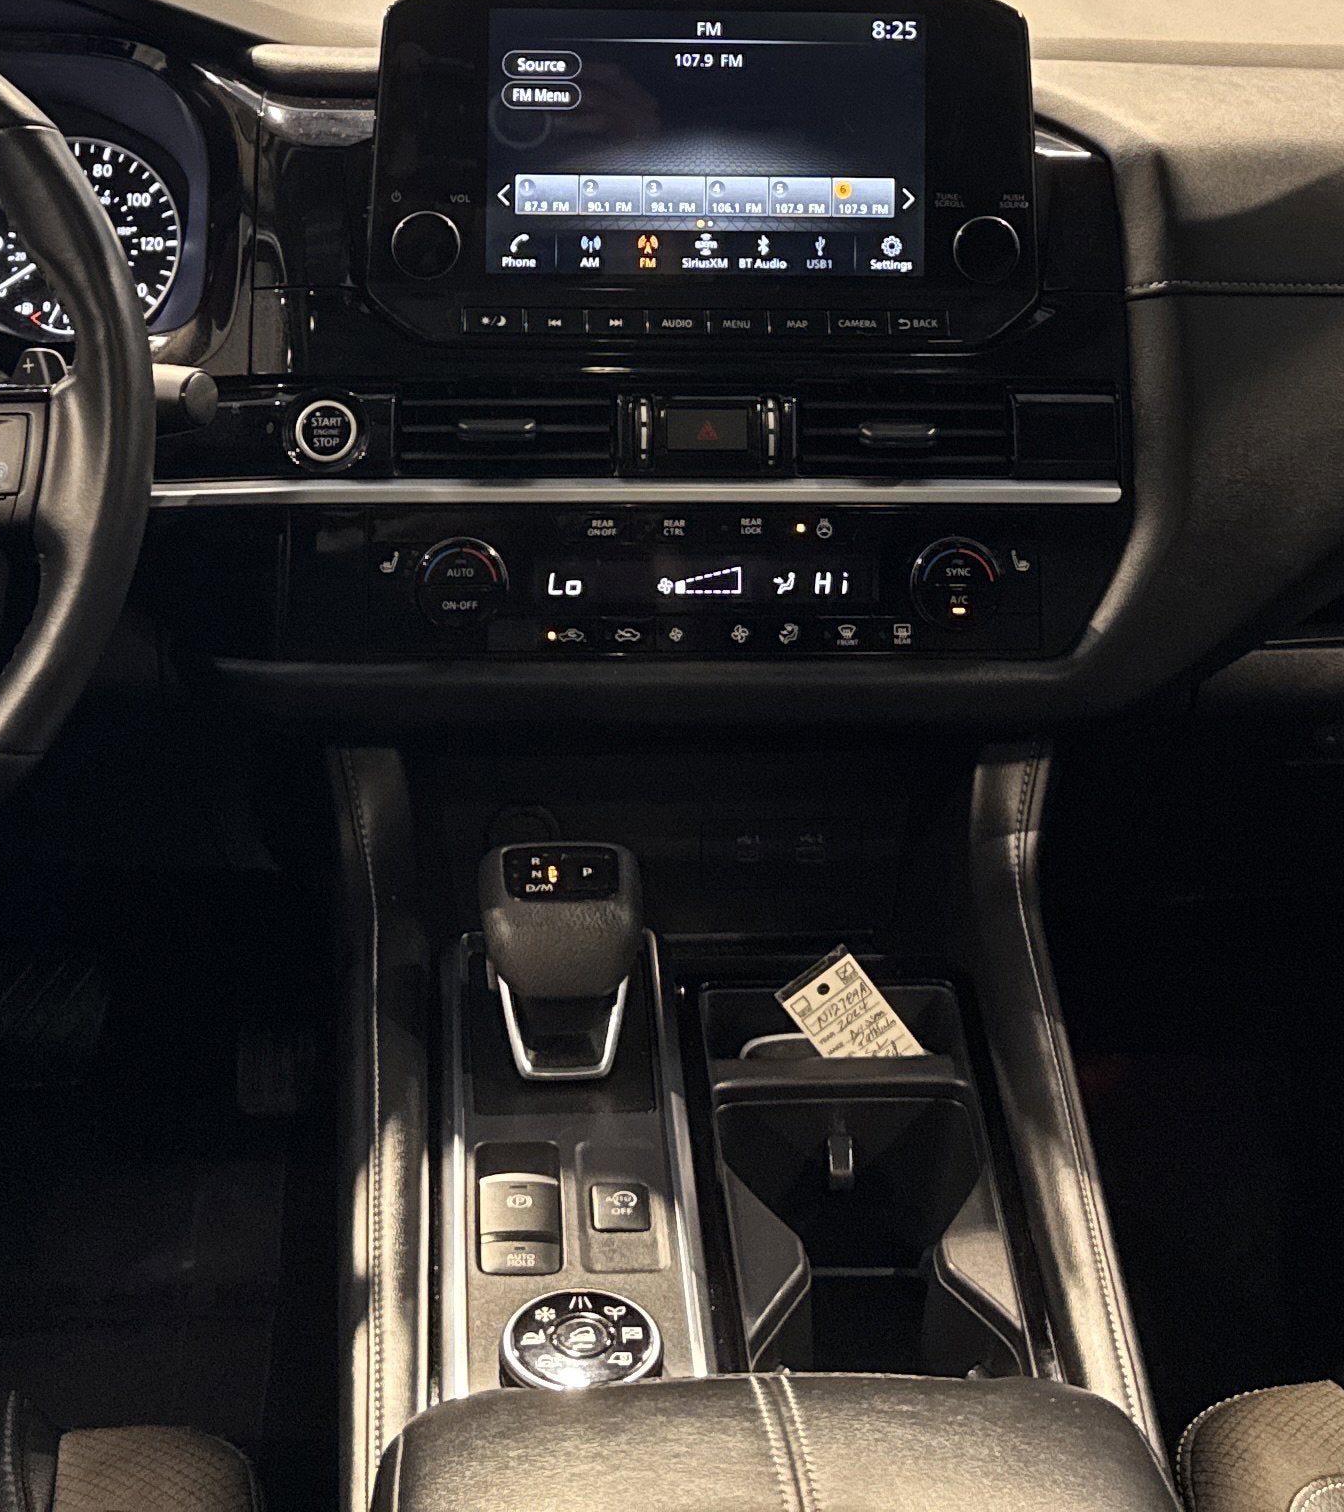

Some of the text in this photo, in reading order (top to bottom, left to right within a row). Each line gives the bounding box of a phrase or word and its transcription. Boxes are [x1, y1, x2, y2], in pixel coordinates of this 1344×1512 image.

[696, 20, 917, 40] FM 8:25
[517, 57, 566, 72] Source
[674, 54, 743, 68] 107.9 FM
[512, 88, 570, 103] FM Menu
[92, 163, 113, 177] 80
[127, 192, 151, 207] 100
[450, 194, 470, 203] VOL
[1003, 194, 1025, 202] PUSH
[524, 201, 569, 213] 87.9 FM
[587, 201, 632, 212] 90.1 FM
[679, 202, 696, 213] FM
[711, 202, 762, 214] 106.1 FM
[775, 202, 825, 214] 107.9 FM
[838, 203, 889, 215] 107.9 FM
[934, 200, 965, 208] SCROLL
[999, 201, 1029, 209] SOUND
[140, 237, 164, 251] 120
[502, 256, 536, 268] Phone
[580, 257, 599, 268] AM
[639, 257, 656, 268] FM
[682, 257, 728, 269] SiriusXM
[739, 257, 787, 270] BT Audio
[806, 258, 832, 270] USB1
[870, 258, 913, 273] Settings
[662, 319, 692, 328] AUDIO
[722, 319, 751, 329] MENU
[786, 319, 808, 328] MAP
[838, 319, 877, 329] CAMERA
[913, 319, 938, 328] BACK
[311, 417, 342, 427] START
[313, 437, 340, 447] STOP
[591, 519, 614, 528] REAR
[664, 520, 685, 528] REAR
[741, 519, 762, 527] REAR
[664, 528, 685, 536] CTRL
[741, 526, 762, 535] LOCK
[446, 568, 474, 577] AUTO
[945, 567, 971, 577] SYNC
[547, 572, 582, 596] Lo
[814, 572, 849, 595] Hi
[950, 595, 968, 605] A/C
[531, 857, 540, 865] R
[531, 870, 542, 878] N
[583, 867, 593, 877] P
[525, 884, 554, 892] D/M
[507, 1253, 536, 1261] AUTO
